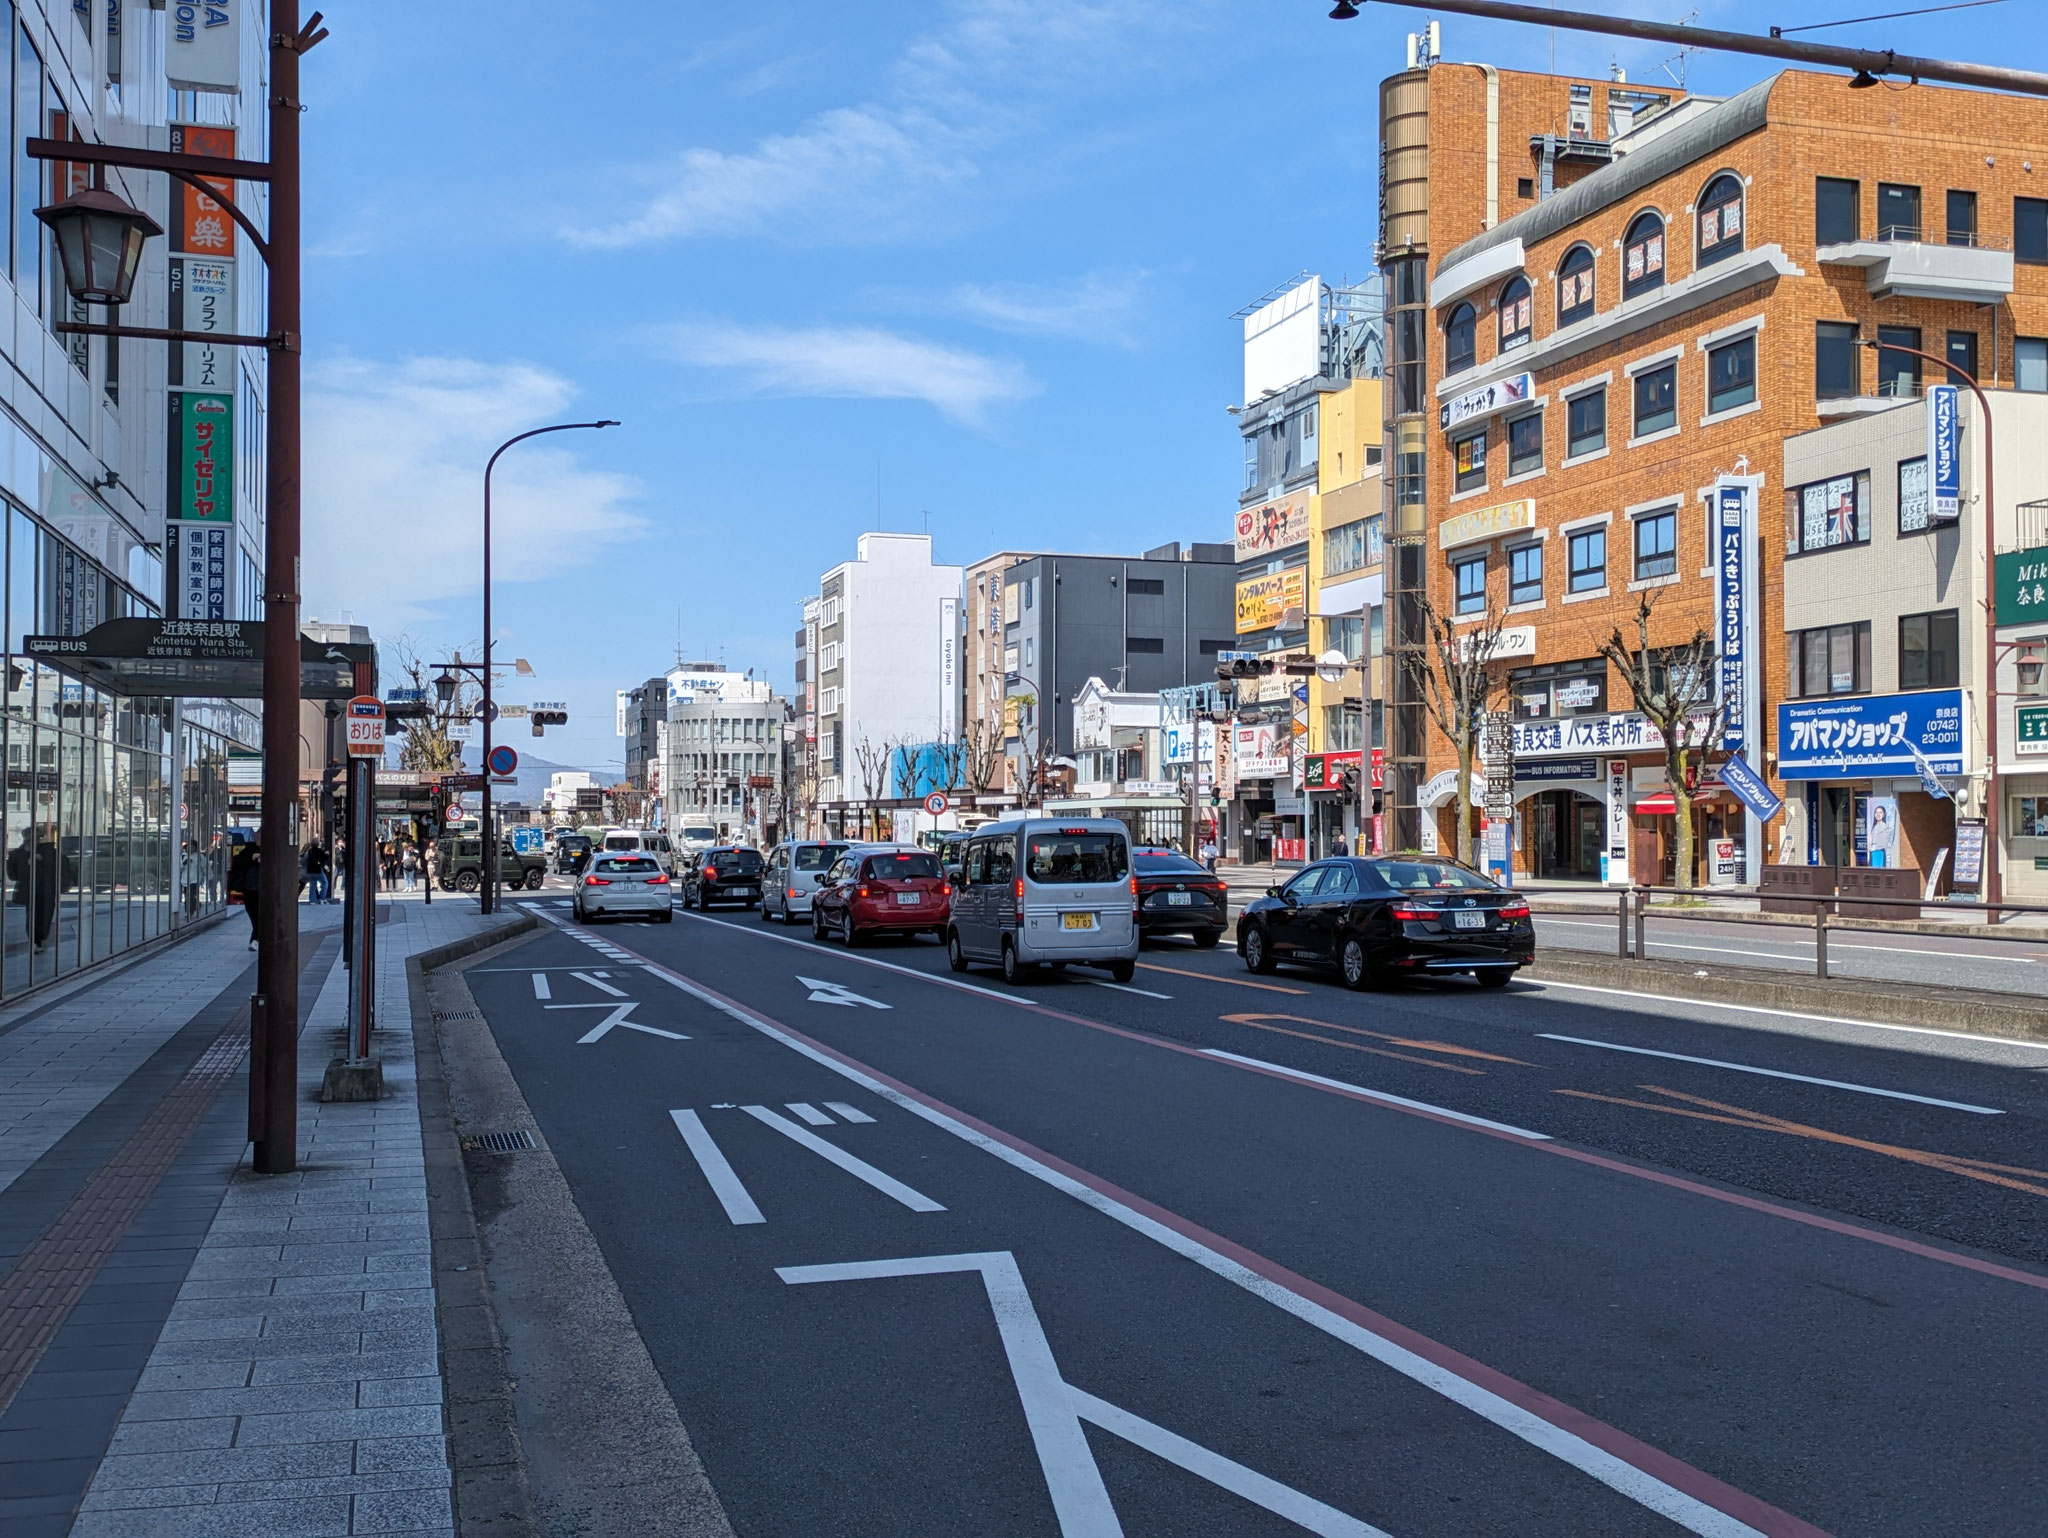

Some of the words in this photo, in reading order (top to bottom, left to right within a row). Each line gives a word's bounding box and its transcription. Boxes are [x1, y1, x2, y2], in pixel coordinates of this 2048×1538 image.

[171, 268, 181, 292] 5F
[200, 296, 217, 386] クラブーリズム
[172, 398, 180, 414] 3F
[1938, 391, 1951, 482] アパマンショップ
[194, 421, 214, 517] サイゼリヤ
[167, 528, 176, 548] 2F
[1724, 533, 1740, 655] バスきっぷうりば
[161, 621, 241, 638] 近鉄奈良駅
[60, 641, 87, 652] BUS
[153, 636, 196, 646] Kintetsu
[200, 638, 225, 647] Nara
[227, 639, 248, 648] Sta.
[944, 639, 952, 669] toyoko
[945, 672, 953, 686] inn
[1789, 708, 1816, 717] Dramatic
[1817, 705, 1863, 715] Communication
[1935, 707, 1959, 718] 奈良店
[350, 722, 382, 740] おりば
[1567, 716, 1643, 749] バス案内所
[1790, 711, 1908, 751] アパマンショップ
[1926, 719, 1959, 732] (0742)
[1921, 731, 1959, 744] 23-0011
[1531, 766, 1542, 775] BUS
[1543, 764, 1581, 775] INFORMATION
[1613, 776, 1624, 798] 牛丼
[1613, 803, 1623, 833] カレー
[1719, 865, 1733, 873] 24H
[1462, 917, 1484, 927] 16-35
